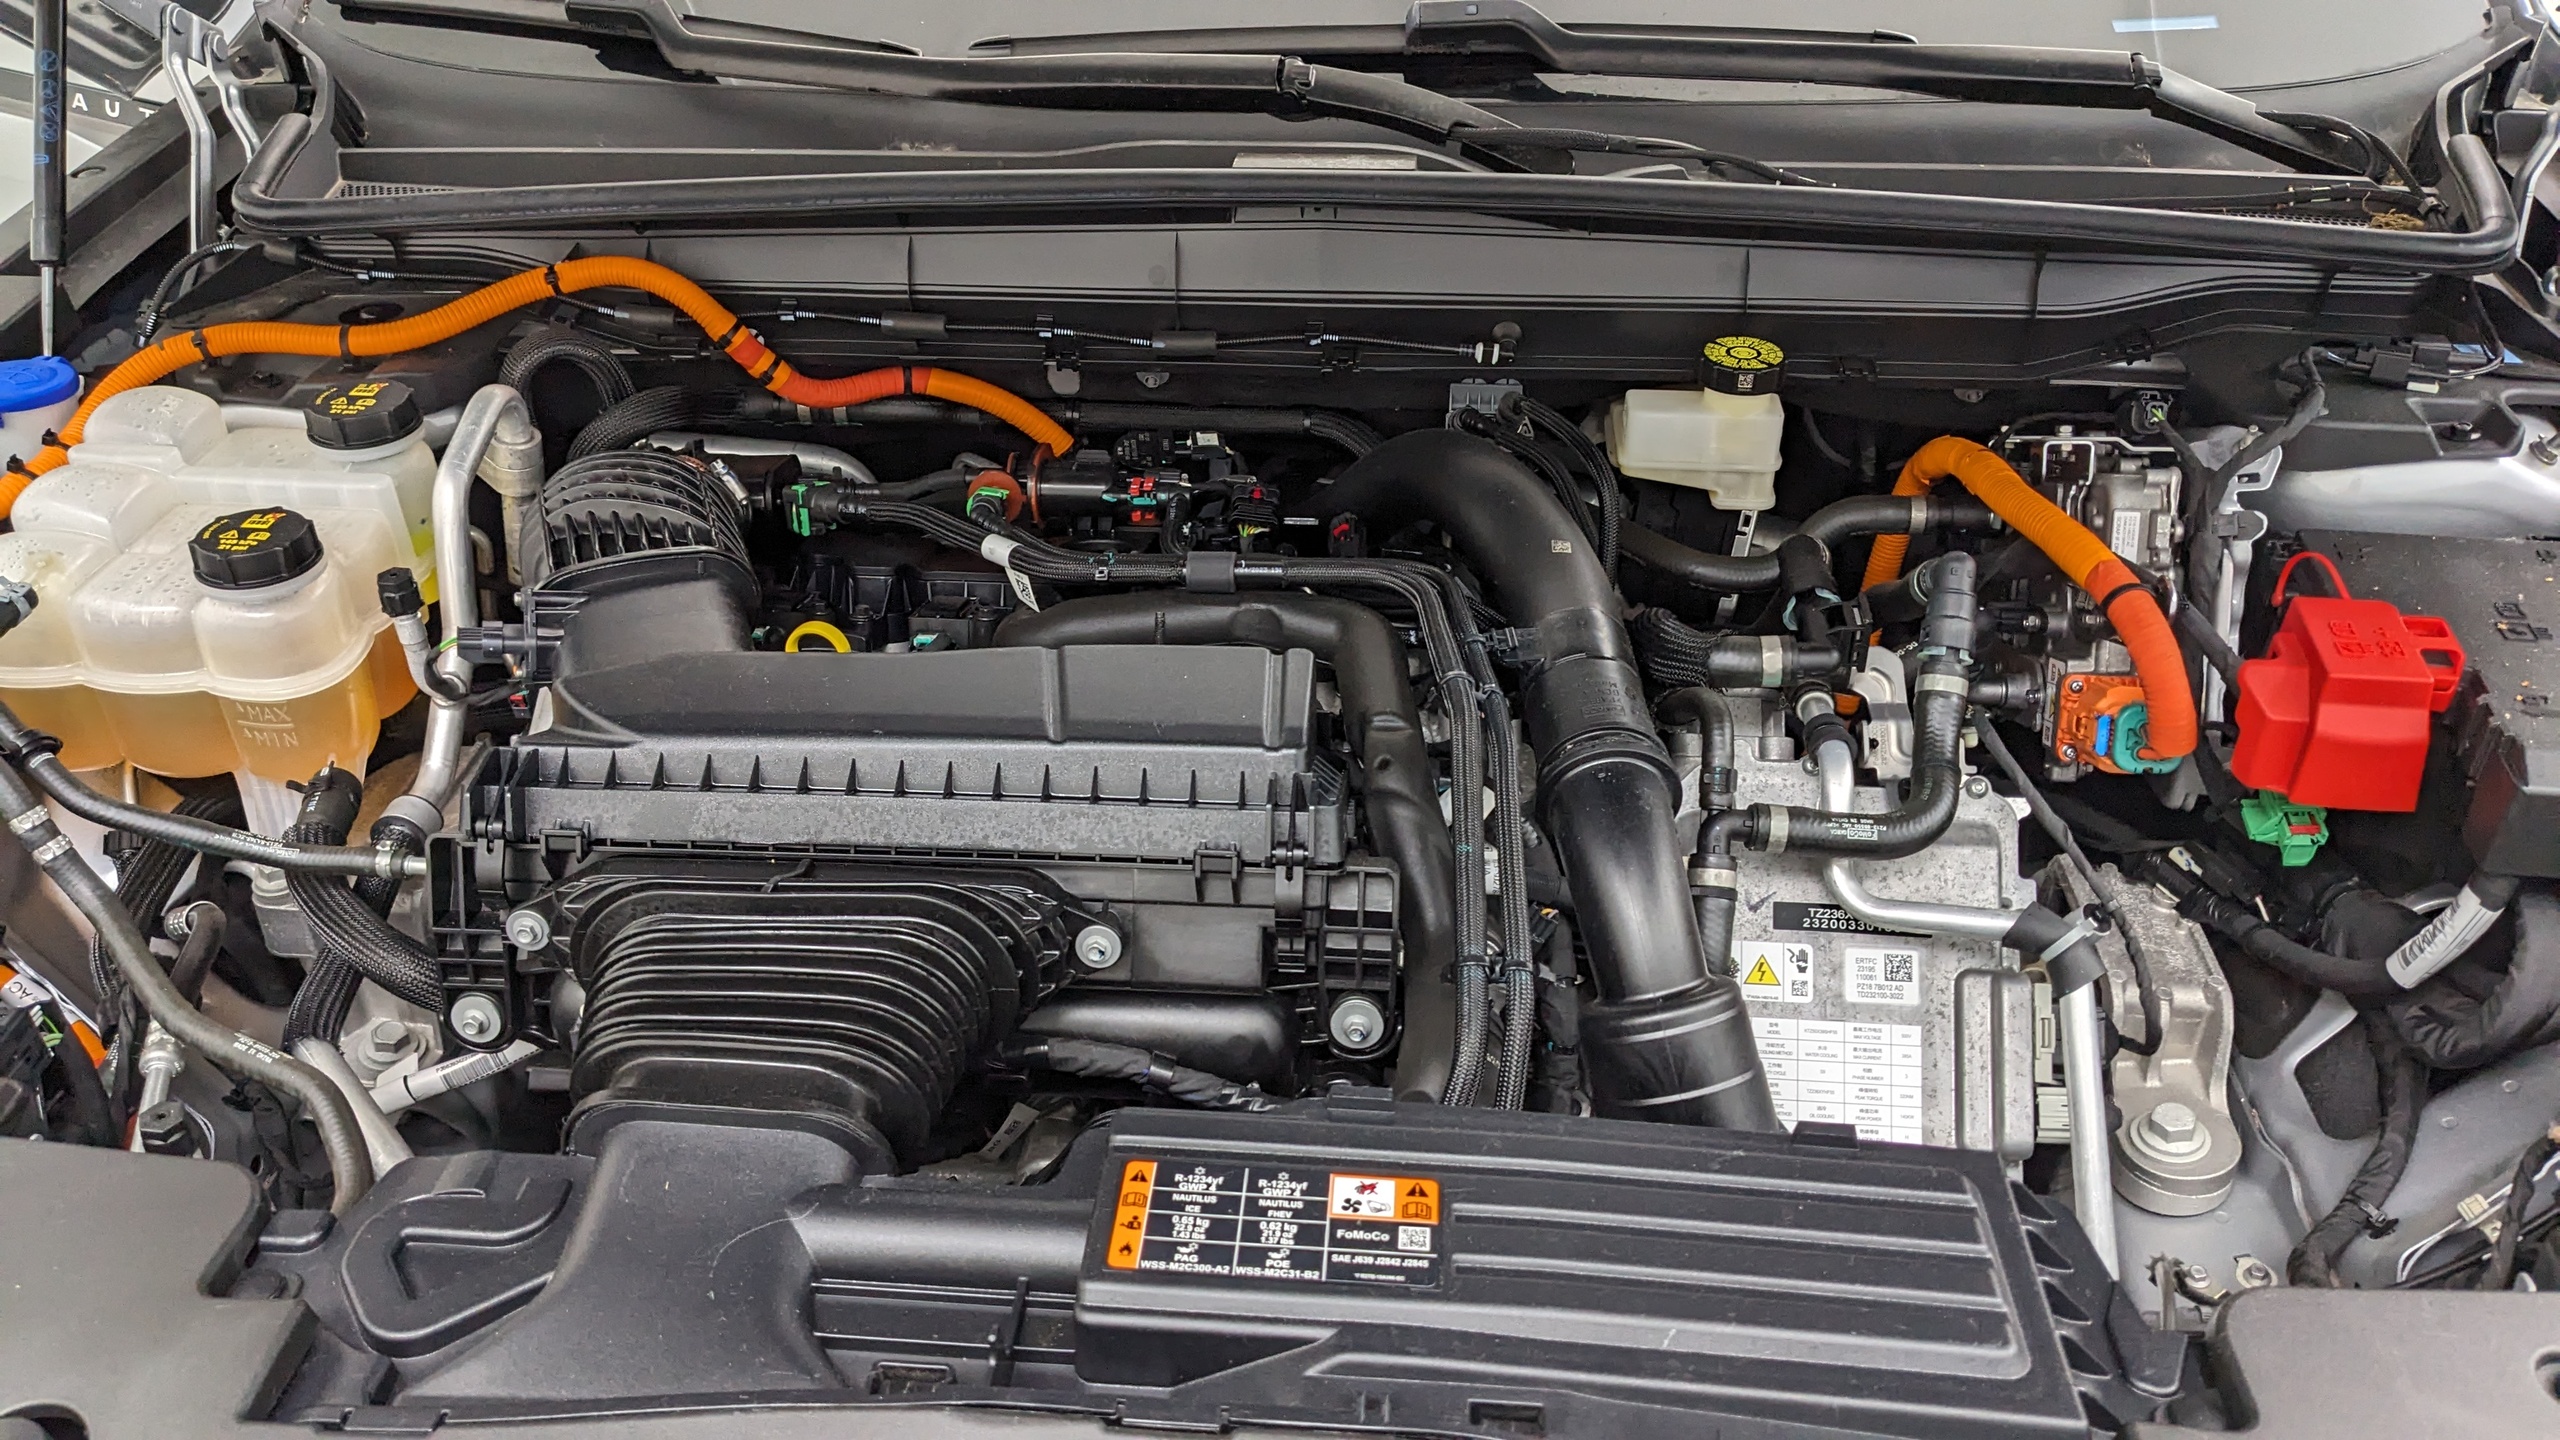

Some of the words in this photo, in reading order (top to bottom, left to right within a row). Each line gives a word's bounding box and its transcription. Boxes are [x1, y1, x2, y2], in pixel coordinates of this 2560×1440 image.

[247, 705, 292, 722] MAX
[254, 731, 299, 747] MIN
[1855, 957, 1878, 965] ERTFC
[9, 982, 33, 999] AC
[1857, 991, 1904, 1000] TD232100-3022
[1174, 1173, 1224, 1185] R-1234yf
[1179, 1182, 1207, 1191] GWP
[1208, 1184, 1217, 1192] 4
[1258, 1179, 1308, 1191] R-1234yf
[1263, 1188, 1291, 1197] GWP
[1293, 1188, 1301, 1197] 4
[1172, 1193, 1217, 1204] NAUTILUS
[1258, 1198, 1304, 1209] NAUTILUS
[1185, 1204, 1201, 1213] ICE
[1267, 1209, 1293, 1219] FHEV
[1172, 1215, 1194, 1225] 0.65
[1196, 1216, 1210, 1228] kg
[1259, 1221, 1282, 1231] 0.62
[1283, 1222, 1298, 1233] kg
[1174, 1224, 1193, 1232] 22.9
[1194, 1225, 1205, 1233] oz
[1262, 1229, 1281, 1238] 21.9
[1282, 1231, 1294, 1239] oz
[1172, 1230, 1190, 1239] 1.43
[1192, 1231, 1206, 1240] lbs
[1336, 1229, 1390, 1242] FoMoCo
[1260, 1236, 1279, 1245] 1.37
[1280, 1237, 1295, 1246] lbs
[1174, 1253, 1199, 1263] PAG
[1265, 1259, 1291, 1268] POE
[1331, 1253, 1351, 1263] SAE
[1352, 1255, 1374, 1265] J639
[1140, 1260, 1230, 1274] WSS-M2C300-A2
[1236, 1266, 1320, 1279] WSS-M2C31-B2
